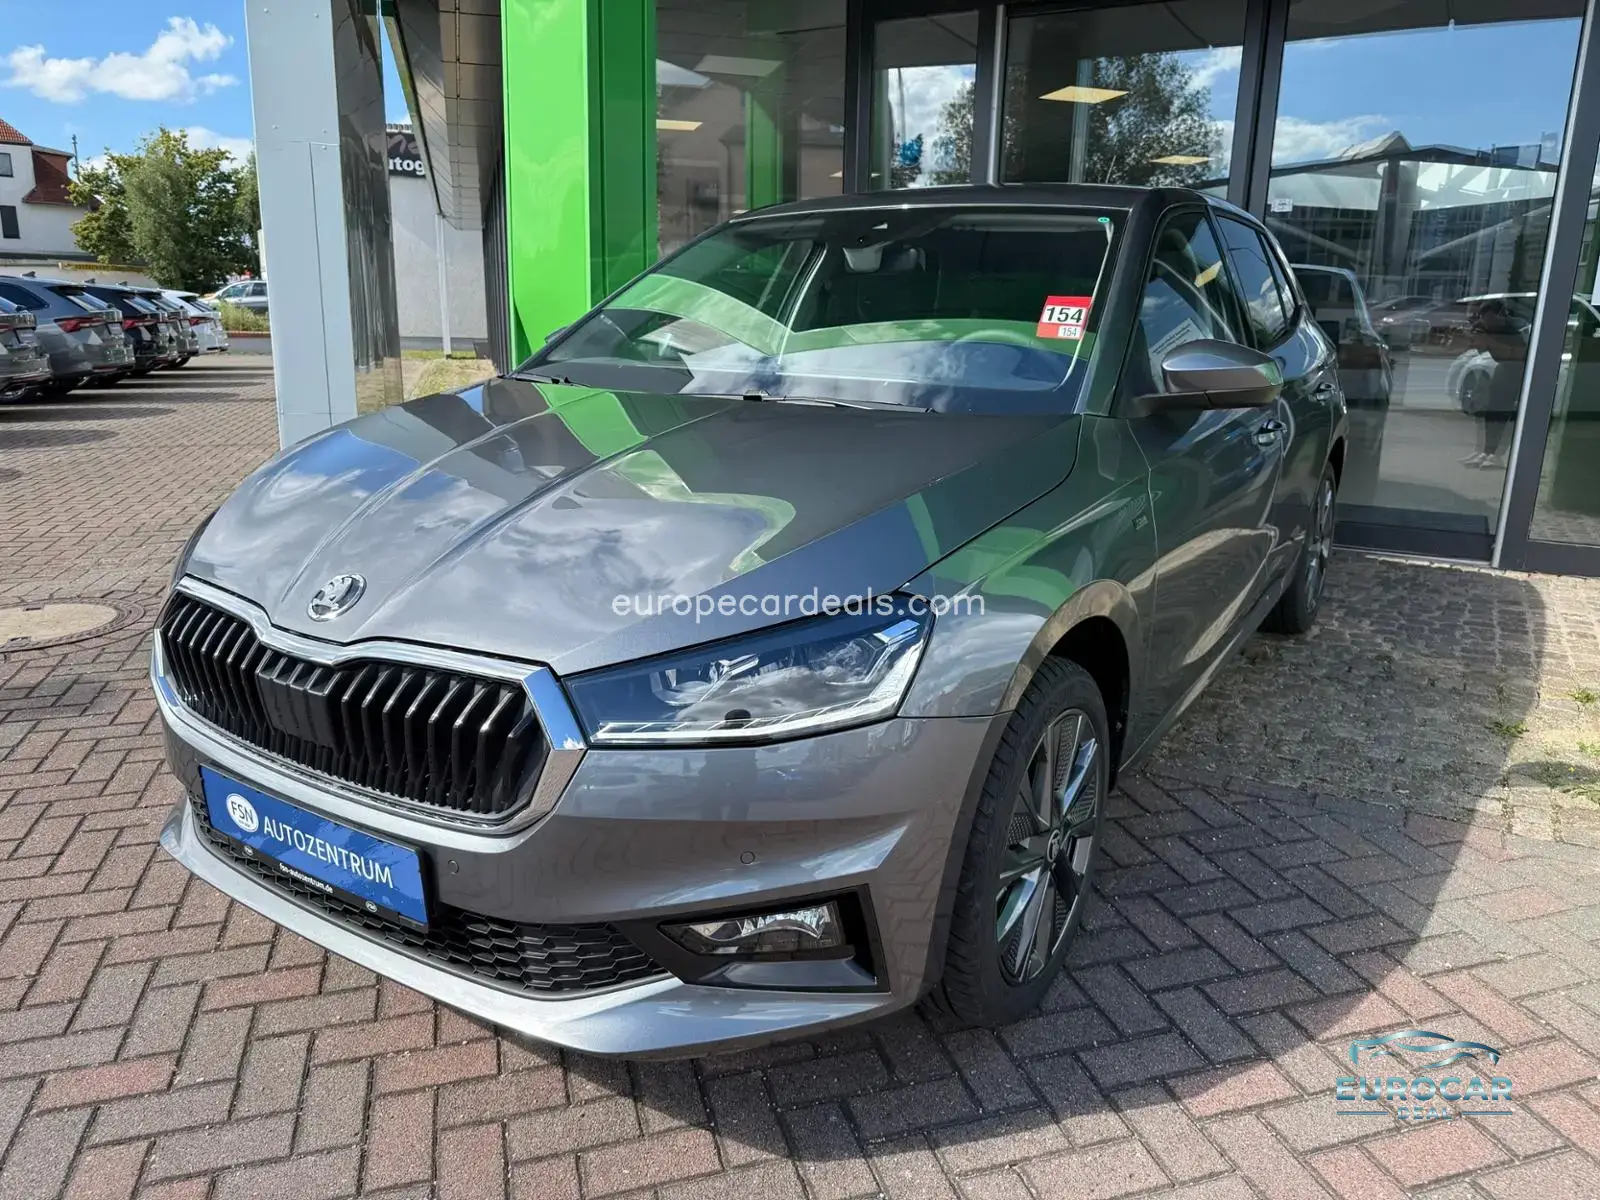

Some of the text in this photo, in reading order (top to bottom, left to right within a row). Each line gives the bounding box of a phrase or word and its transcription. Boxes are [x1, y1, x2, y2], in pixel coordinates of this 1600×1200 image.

[1046, 306, 1083, 323] 154
[1062, 327, 1077, 337] 154
[230, 800, 254, 824] FSN
[263, 815, 394, 889] AUTOZENTRUM
